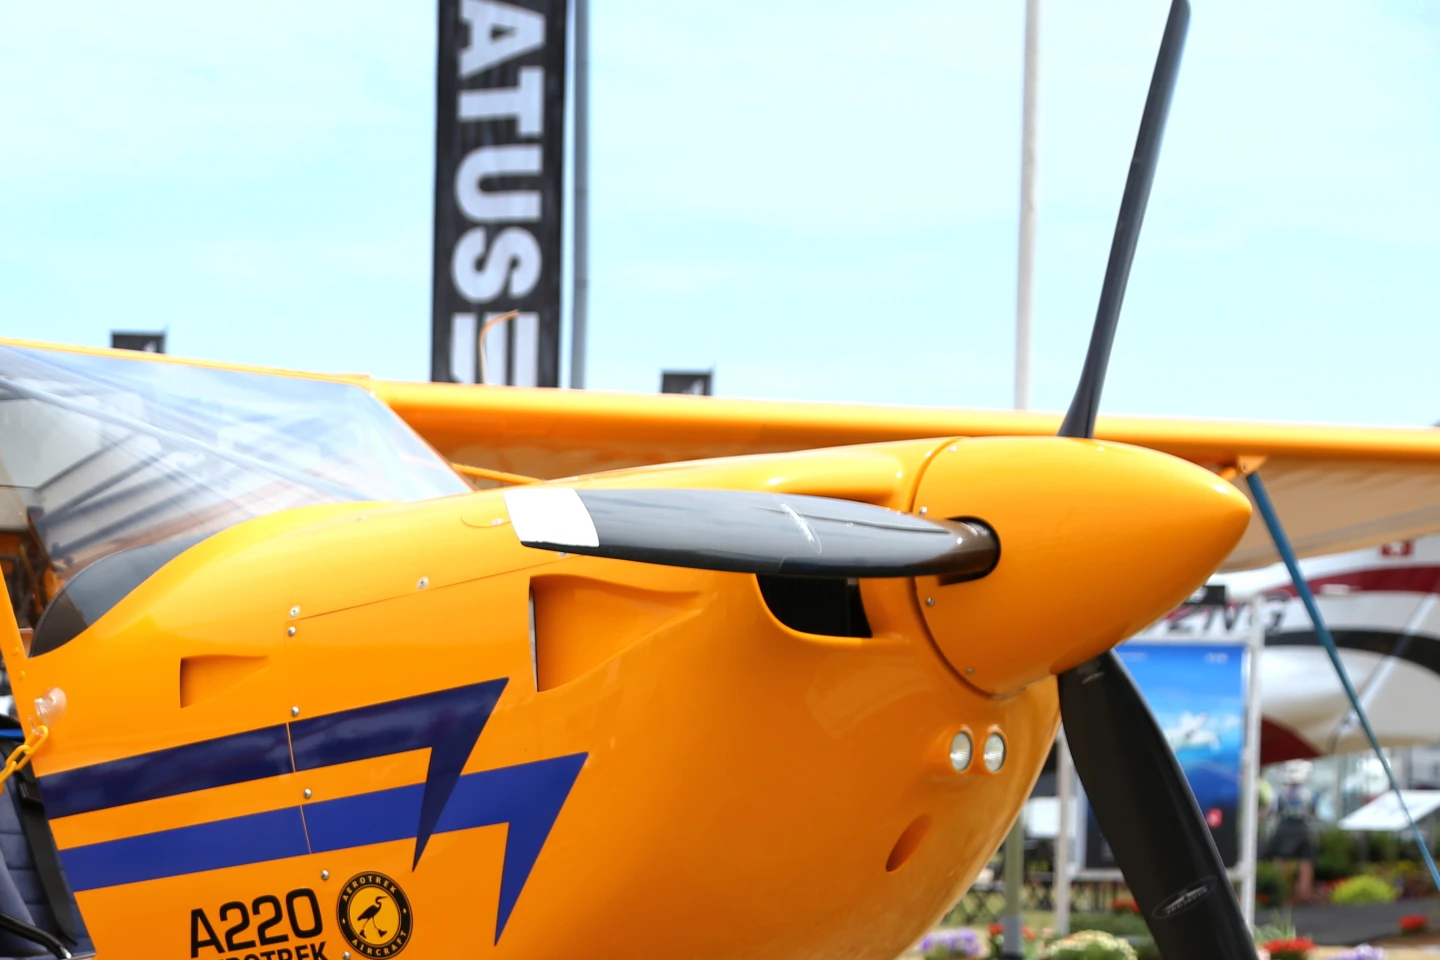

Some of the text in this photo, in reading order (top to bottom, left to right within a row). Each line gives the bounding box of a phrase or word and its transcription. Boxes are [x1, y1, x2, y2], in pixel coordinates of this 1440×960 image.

[342, 875, 397, 901] AEROTREK
[190, 887, 323, 959] A220
[351, 929, 407, 956] AIRCRAFT
